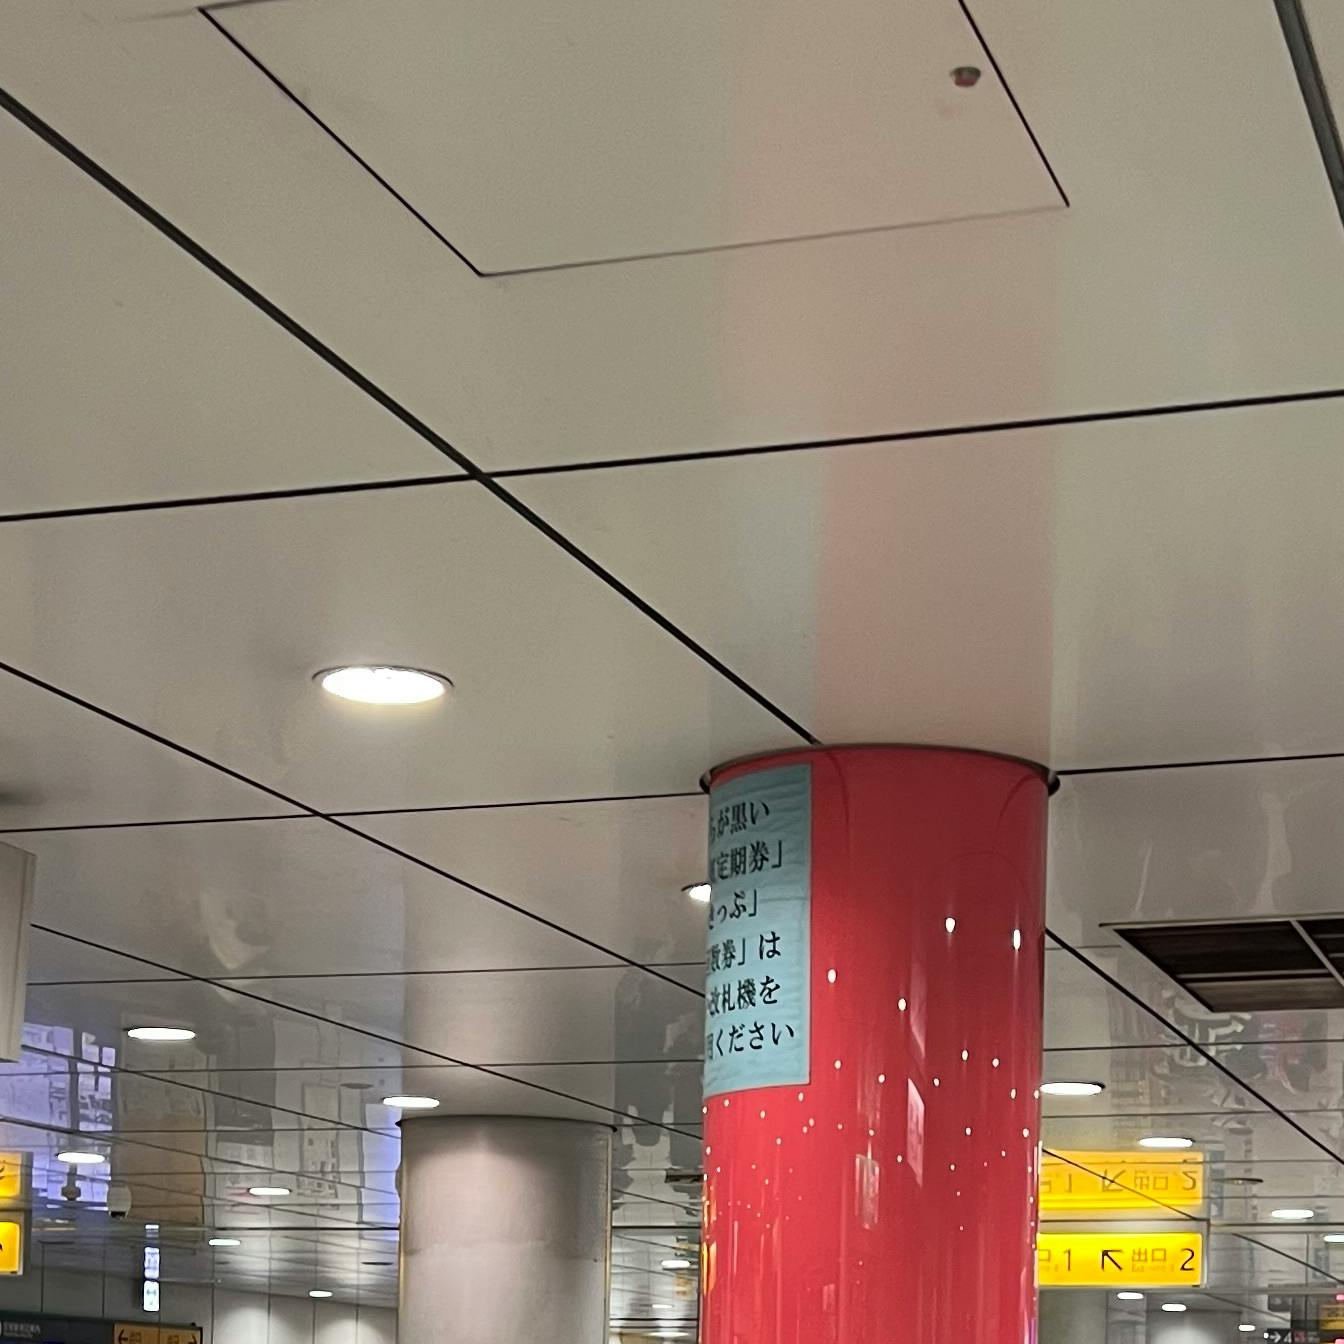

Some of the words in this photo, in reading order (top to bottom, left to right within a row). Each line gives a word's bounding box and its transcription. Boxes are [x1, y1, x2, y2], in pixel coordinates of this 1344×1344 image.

[709, 840, 782, 881] 定期券」
[707, 930, 782, 972] 数券」は
[1063, 1248, 1072, 1272] 1
[1132, 1248, 1167, 1263] 出口
[1179, 1247, 1195, 1271] 2
